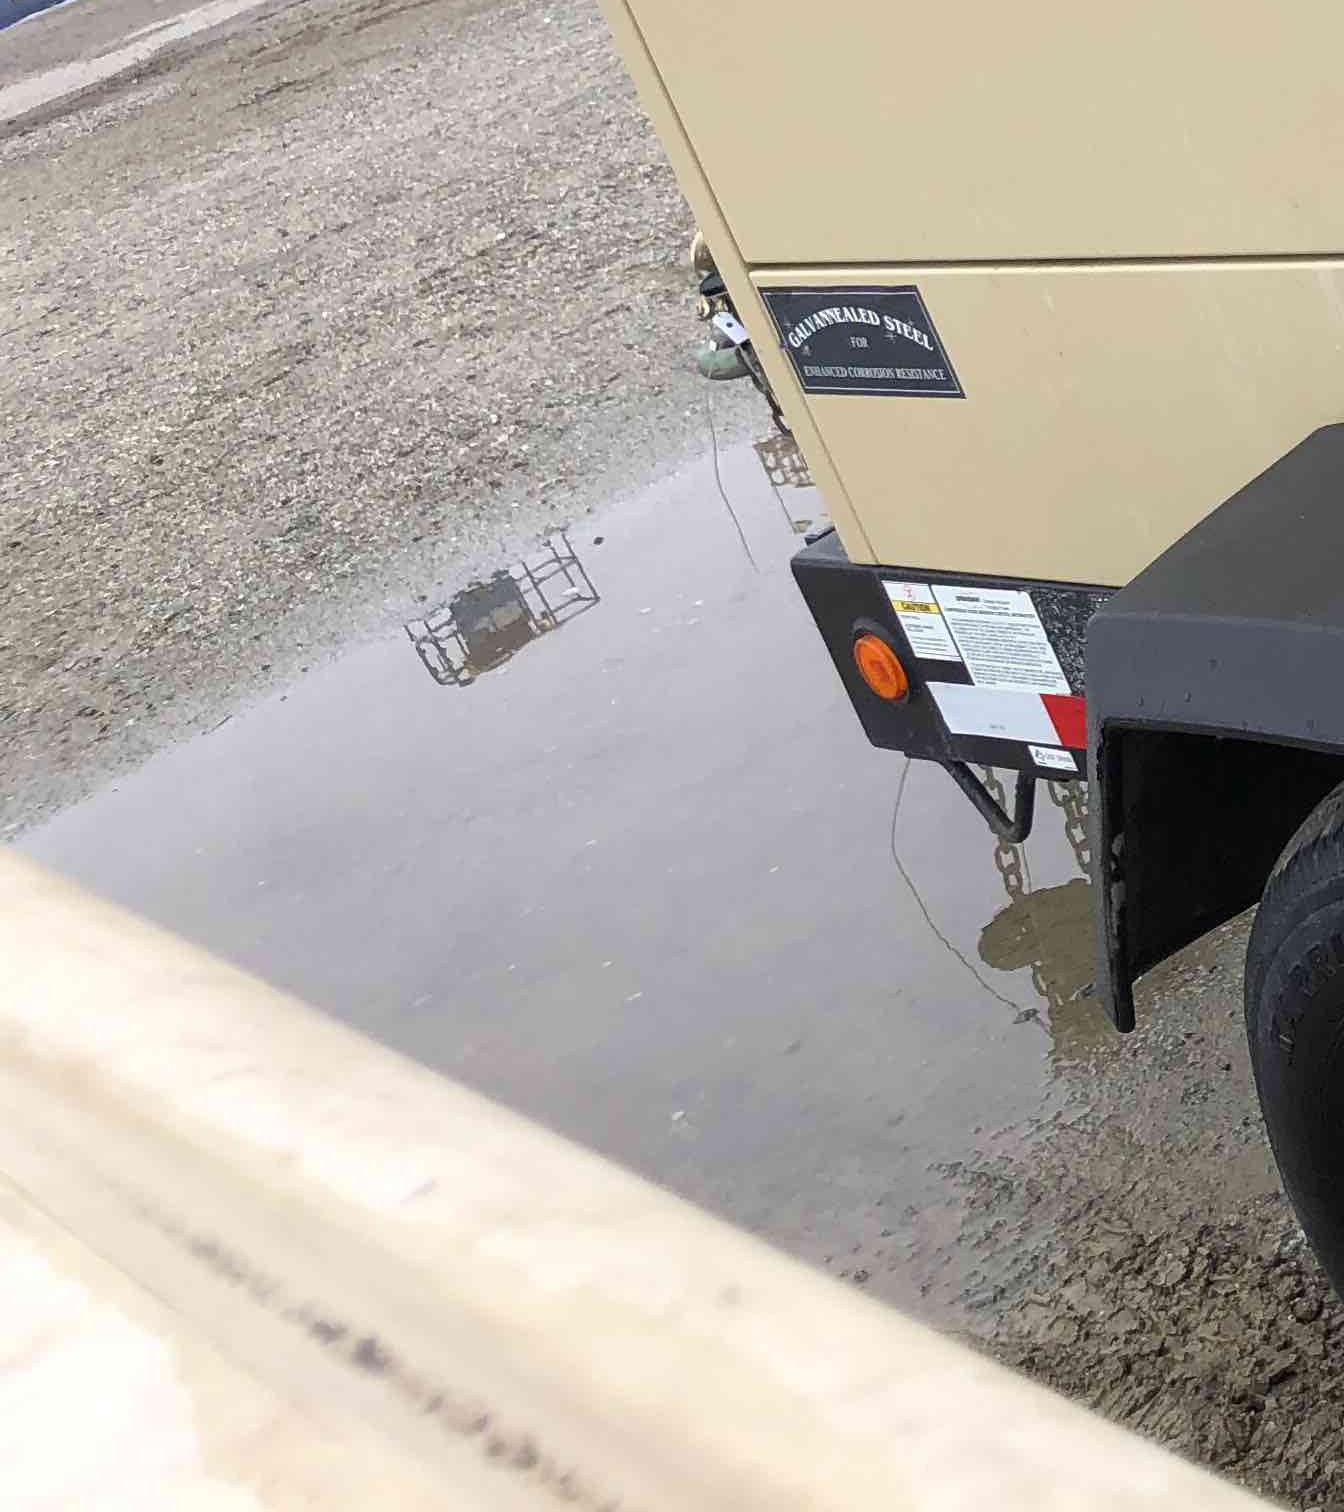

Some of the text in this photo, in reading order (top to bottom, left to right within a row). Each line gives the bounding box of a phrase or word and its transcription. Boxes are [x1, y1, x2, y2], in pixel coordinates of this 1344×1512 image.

[788, 306, 934, 352] GALVANNEALED STEEL
[850, 336, 870, 349] FOR
